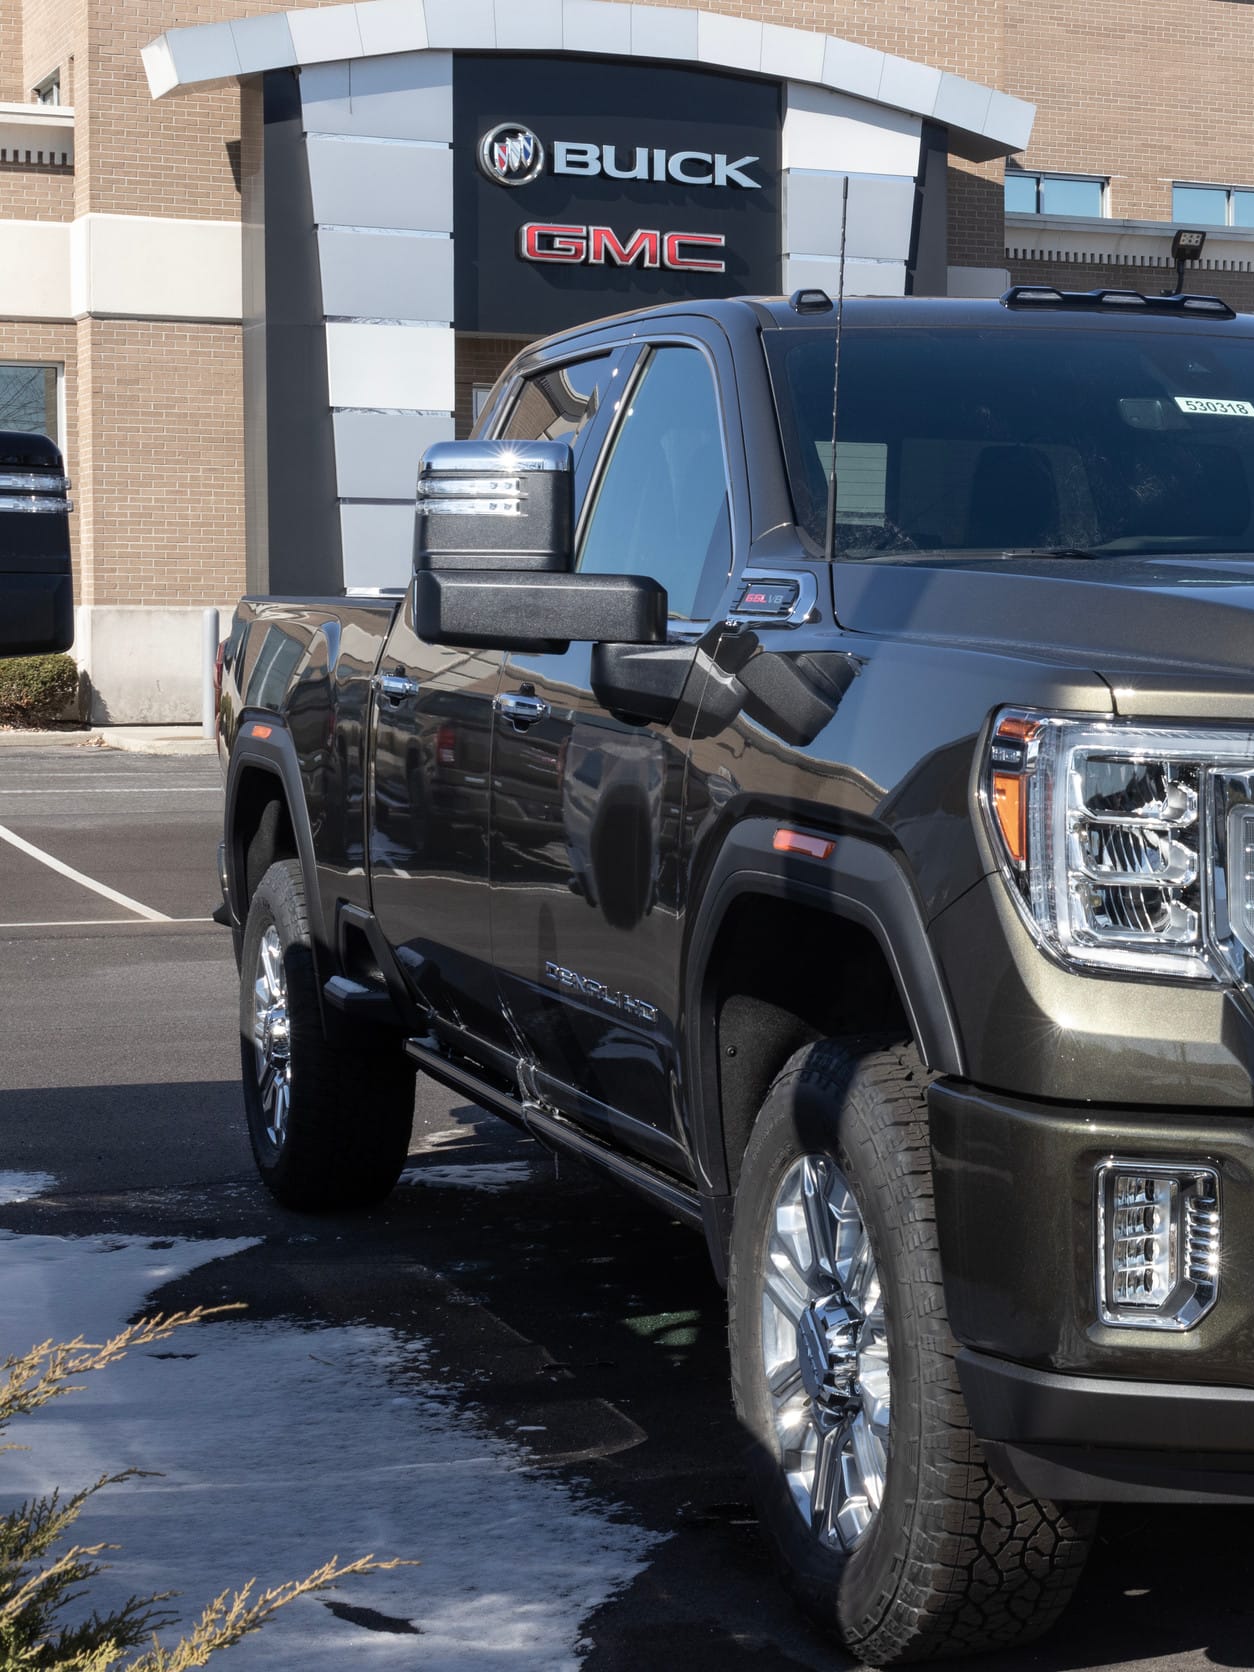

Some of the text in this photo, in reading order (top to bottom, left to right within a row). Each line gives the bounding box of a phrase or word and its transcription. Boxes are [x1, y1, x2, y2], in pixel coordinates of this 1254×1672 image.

[554, 141, 762, 188] BUICK
[520, 222, 726, 273] GMC
[1185, 400, 1249, 415] 530318
